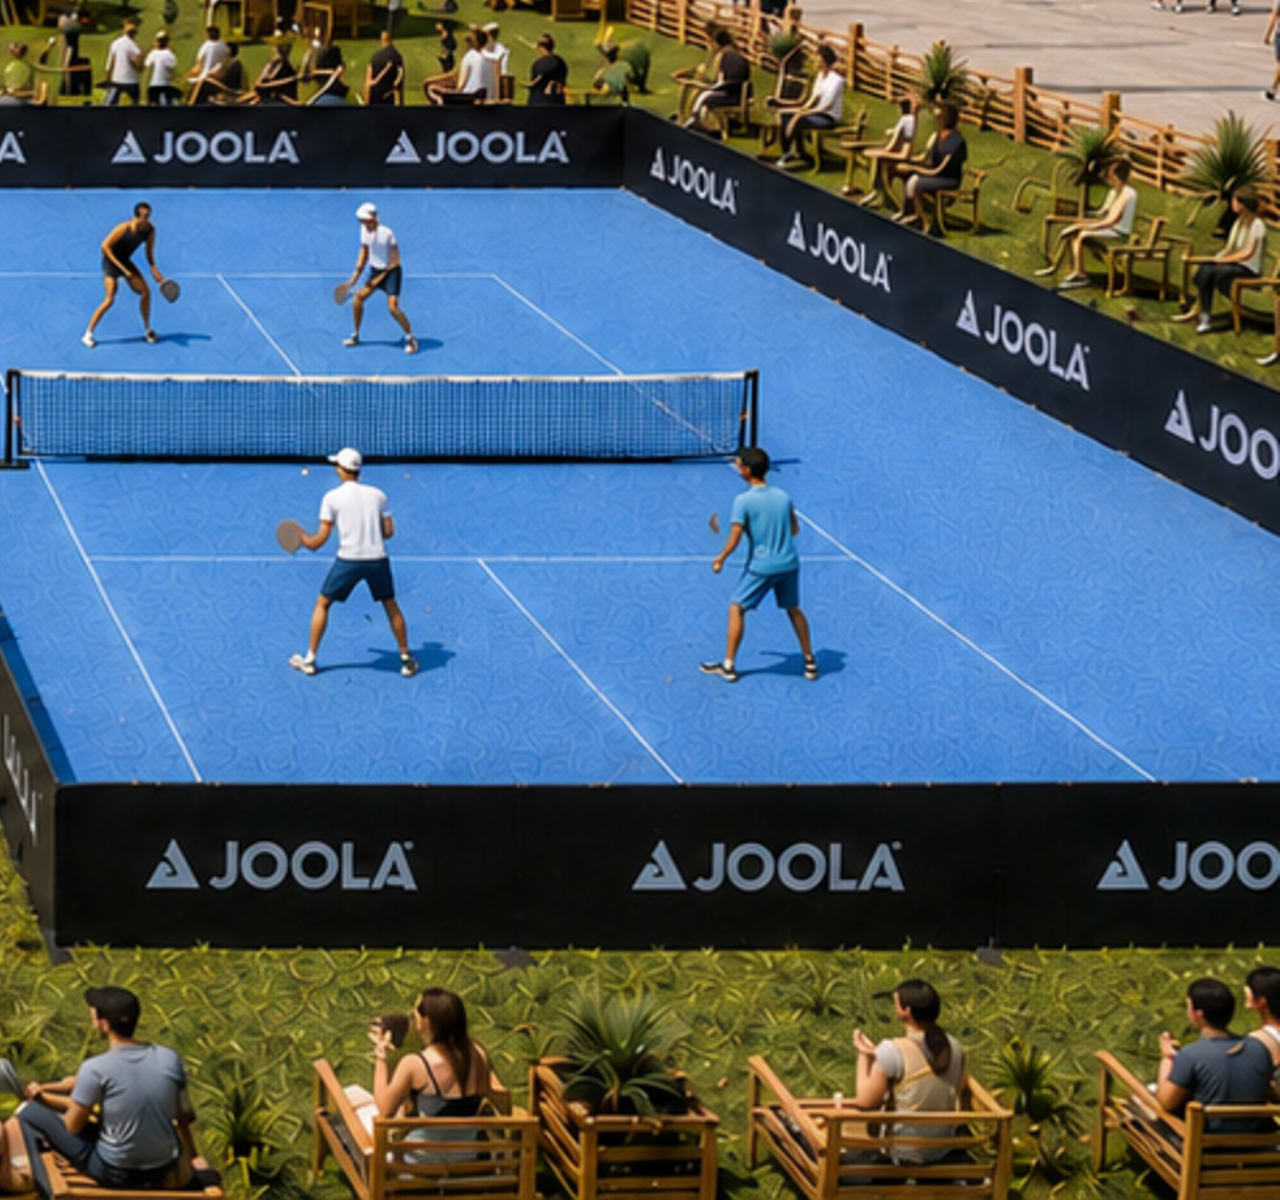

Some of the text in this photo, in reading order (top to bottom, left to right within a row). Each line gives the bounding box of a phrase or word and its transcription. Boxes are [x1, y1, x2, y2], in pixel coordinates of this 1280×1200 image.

[154, 132, 299, 163] JOOLA
[427, 131, 568, 162] JOOLA
[665, 155, 739, 215] JOOLA
[809, 222, 893, 293] JOOLA
[983, 303, 1091, 392] JOOLA
[210, 841, 416, 889] JOOLA
[694, 843, 904, 890] JOOLA
